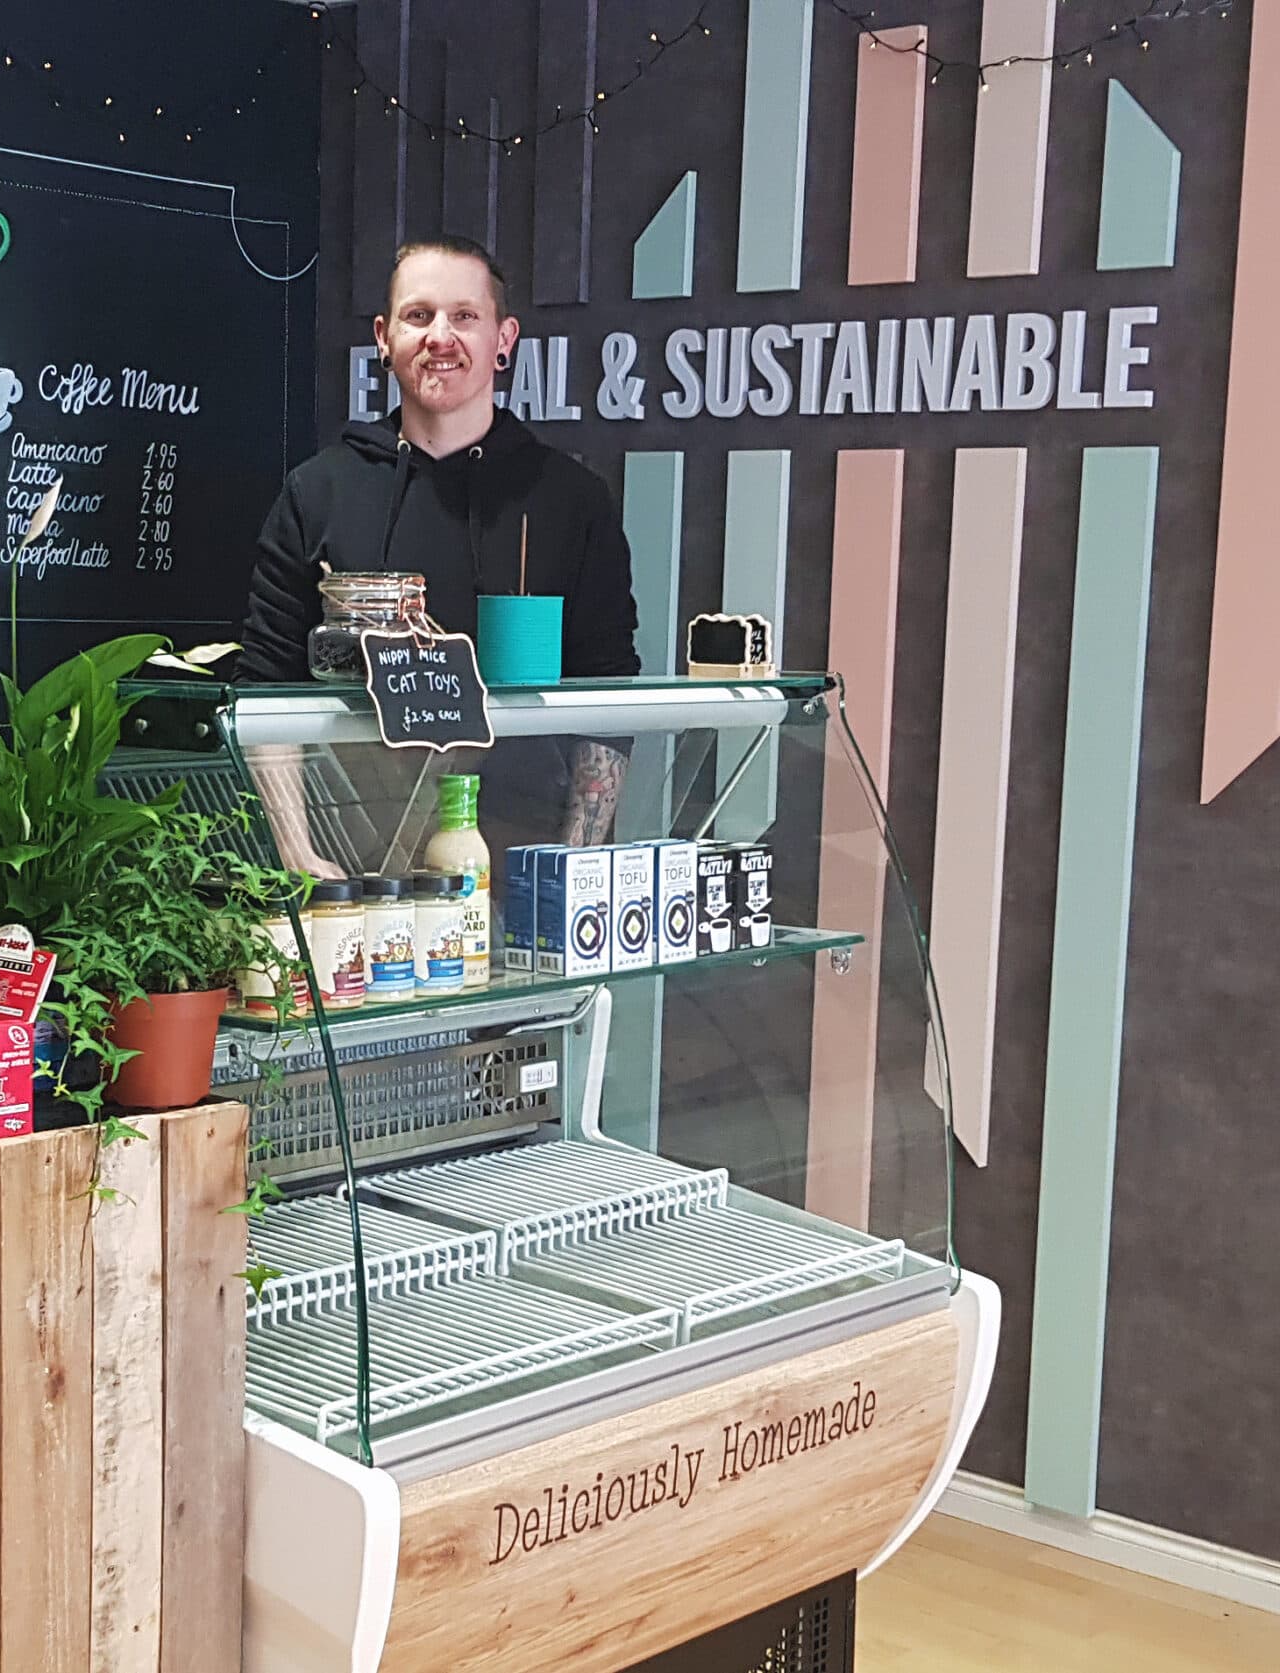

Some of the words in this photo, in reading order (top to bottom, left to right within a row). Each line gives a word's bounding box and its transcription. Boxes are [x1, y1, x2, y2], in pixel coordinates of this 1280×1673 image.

[599, 331, 645, 421] &
[662, 306, 1158, 419] SUSTAINABLE
[38, 363, 115, 415] Coffee
[121, 367, 200, 415] Menu
[8, 460, 58, 486] Latte
[6, 486, 104, 516] Capcino
[7, 512, 64, 538] Moa
[72, 539, 111, 568] Latte
[387, 671, 418, 694] CAT
[423, 671, 461, 698] TOYS
[572, 876, 604, 891] TOFU
[619, 871, 648, 886] TOFU
[665, 866, 691, 881] TOFU
[488, 1444, 705, 1566] Deliciously
[718, 1381, 877, 1483] Homemade
